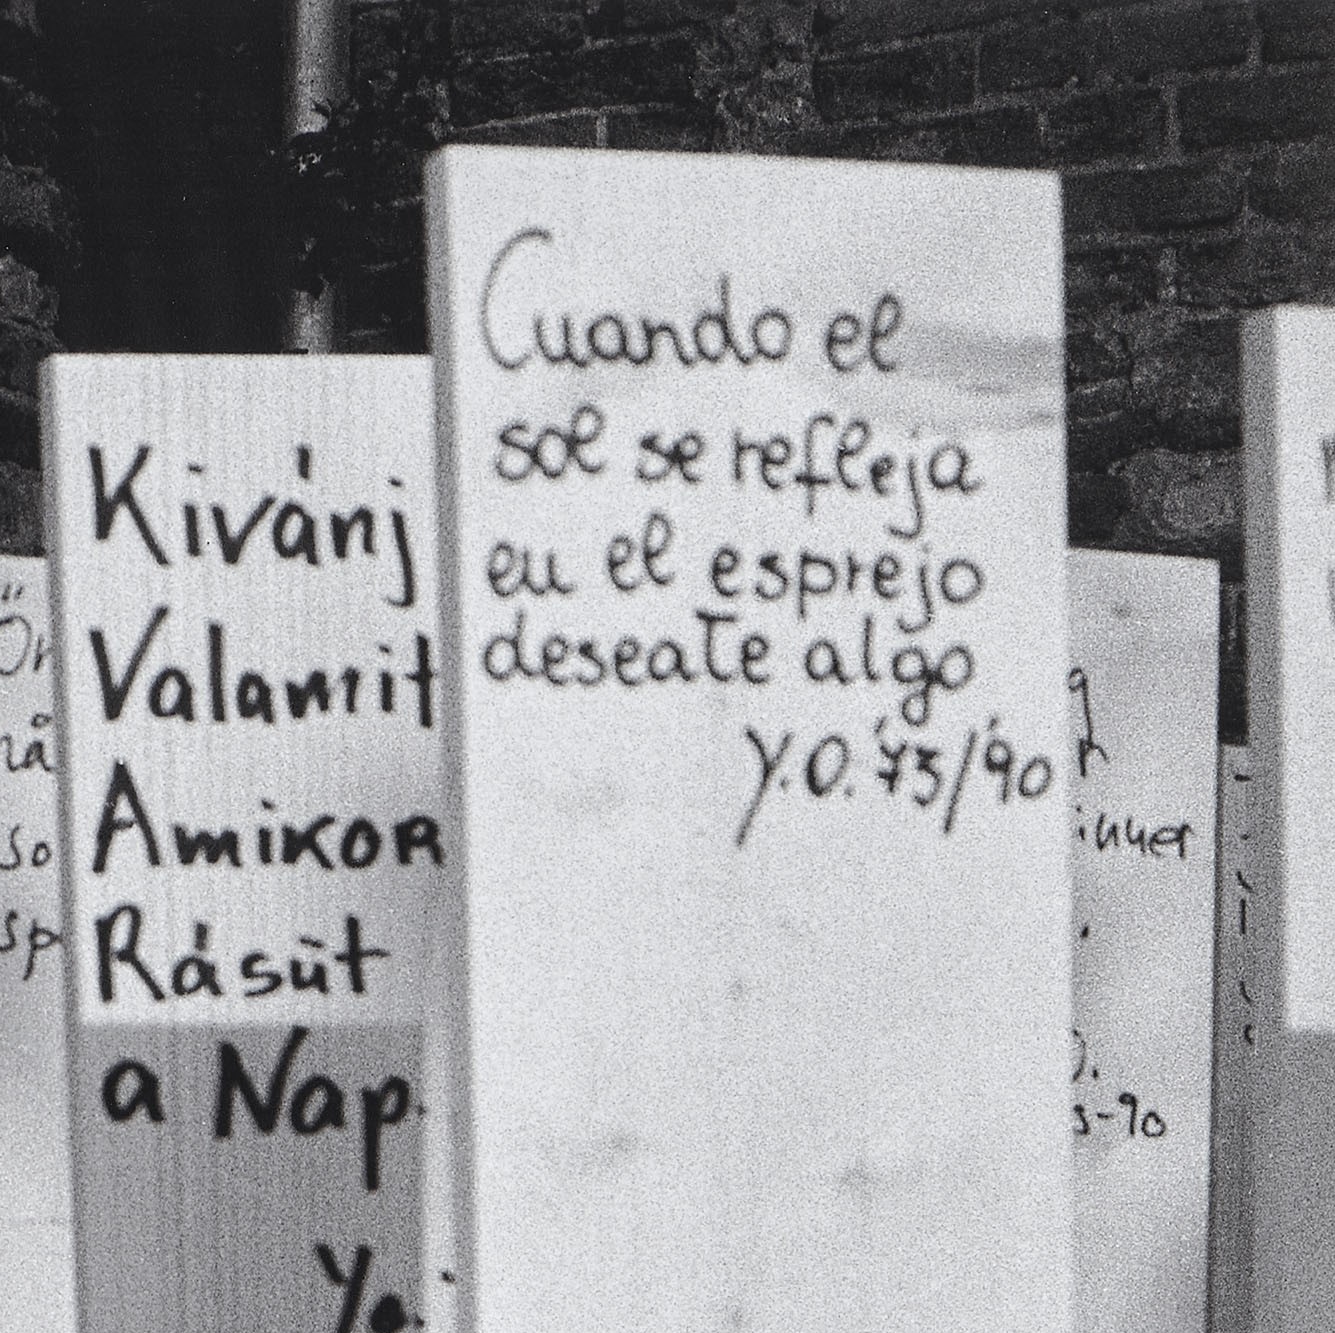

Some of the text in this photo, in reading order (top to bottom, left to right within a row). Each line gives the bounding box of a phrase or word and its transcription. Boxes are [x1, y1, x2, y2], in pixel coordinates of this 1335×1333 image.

[480, 226, 904, 373] Cuando el
[88, 444, 416, 608] Kivánj
[493, 403, 981, 541] sol se refleja
[606, 512, 674, 591] el
[88, 605, 437, 729] Valamit
[804, 616, 976, 727] algo
[102, 1060, 166, 1123] a
